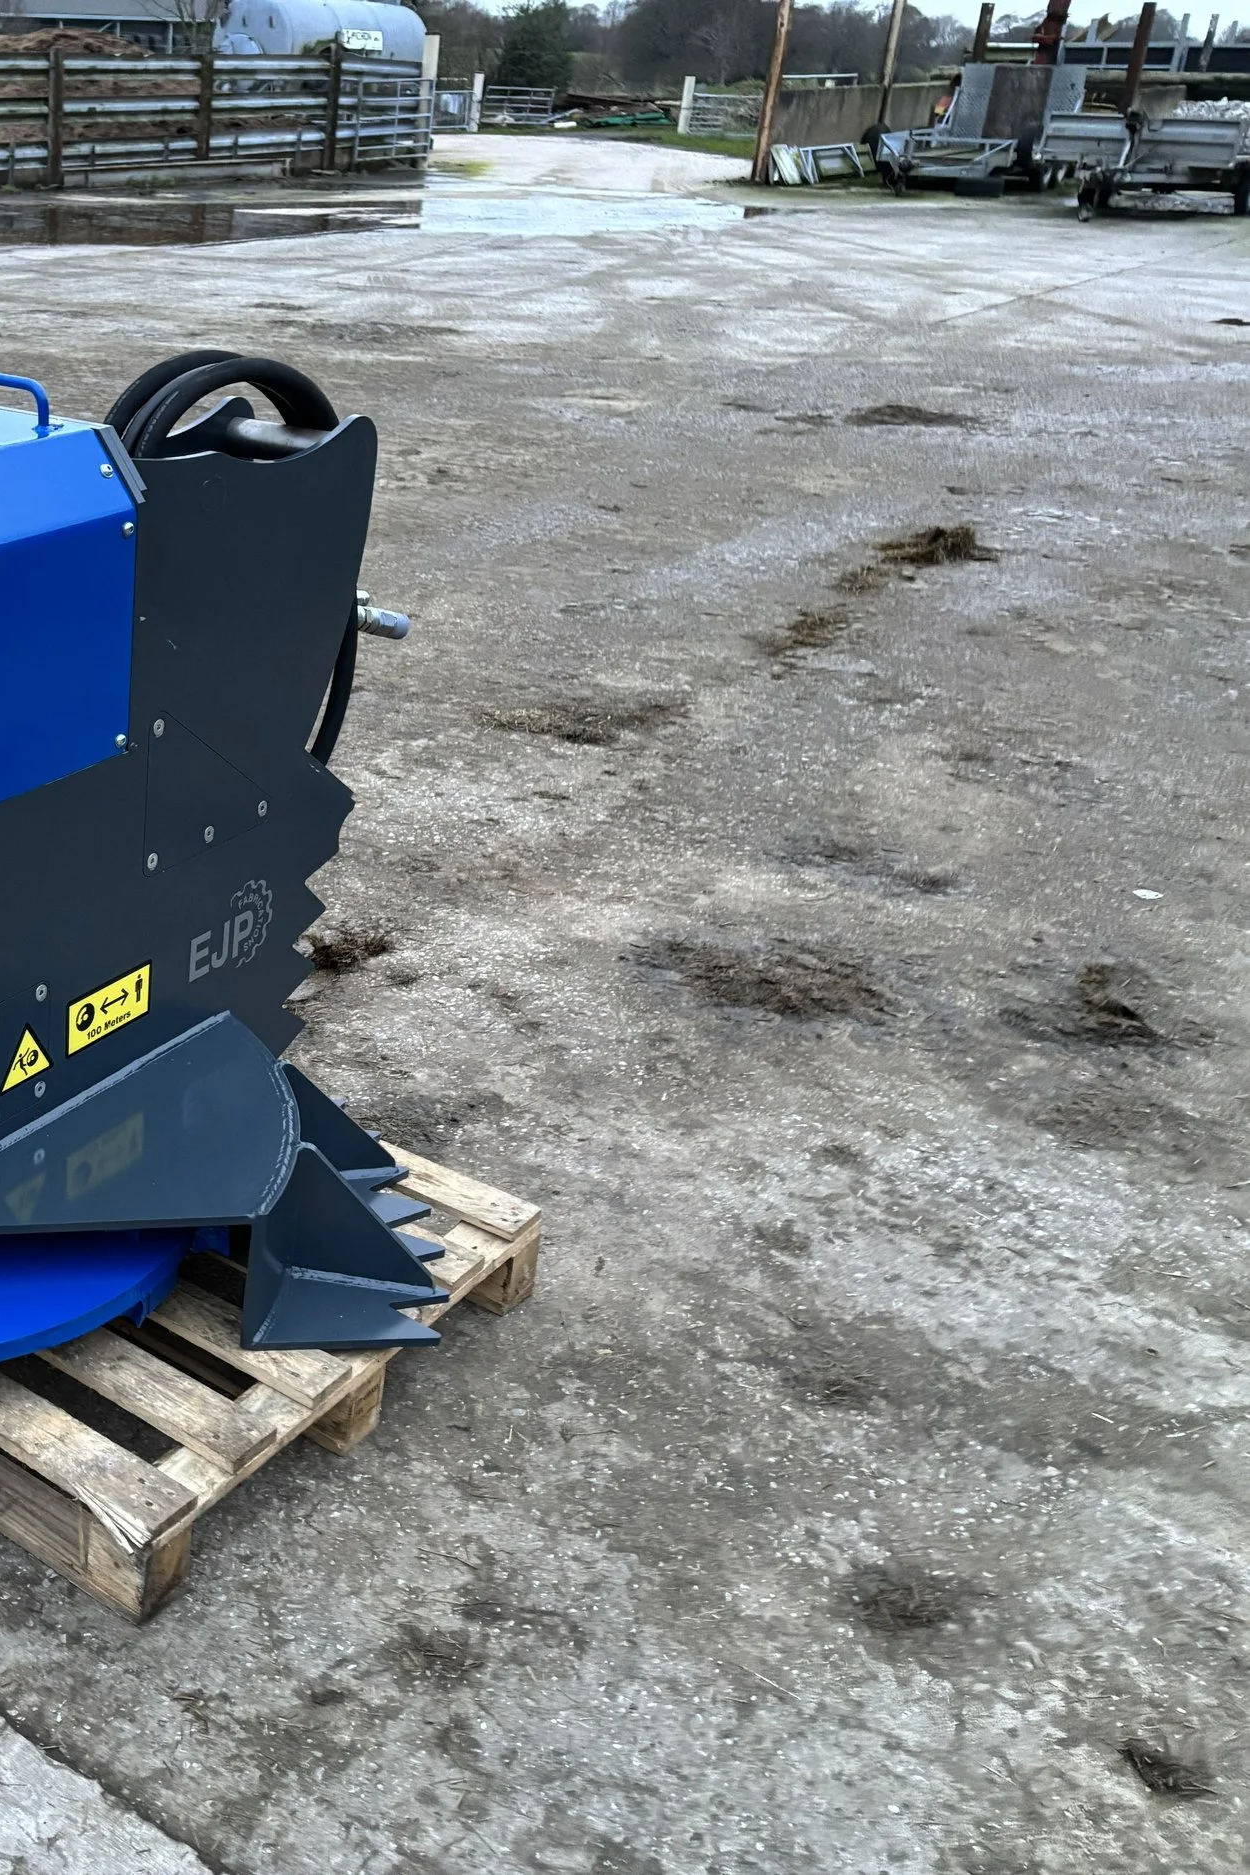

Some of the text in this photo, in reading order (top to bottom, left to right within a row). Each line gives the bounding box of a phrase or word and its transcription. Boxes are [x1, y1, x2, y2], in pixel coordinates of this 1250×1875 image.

[189, 910, 254, 982] EJP
[238, 893, 264, 951] FABRICATIONS
[87, 1011, 132, 1040] 100 Meters
